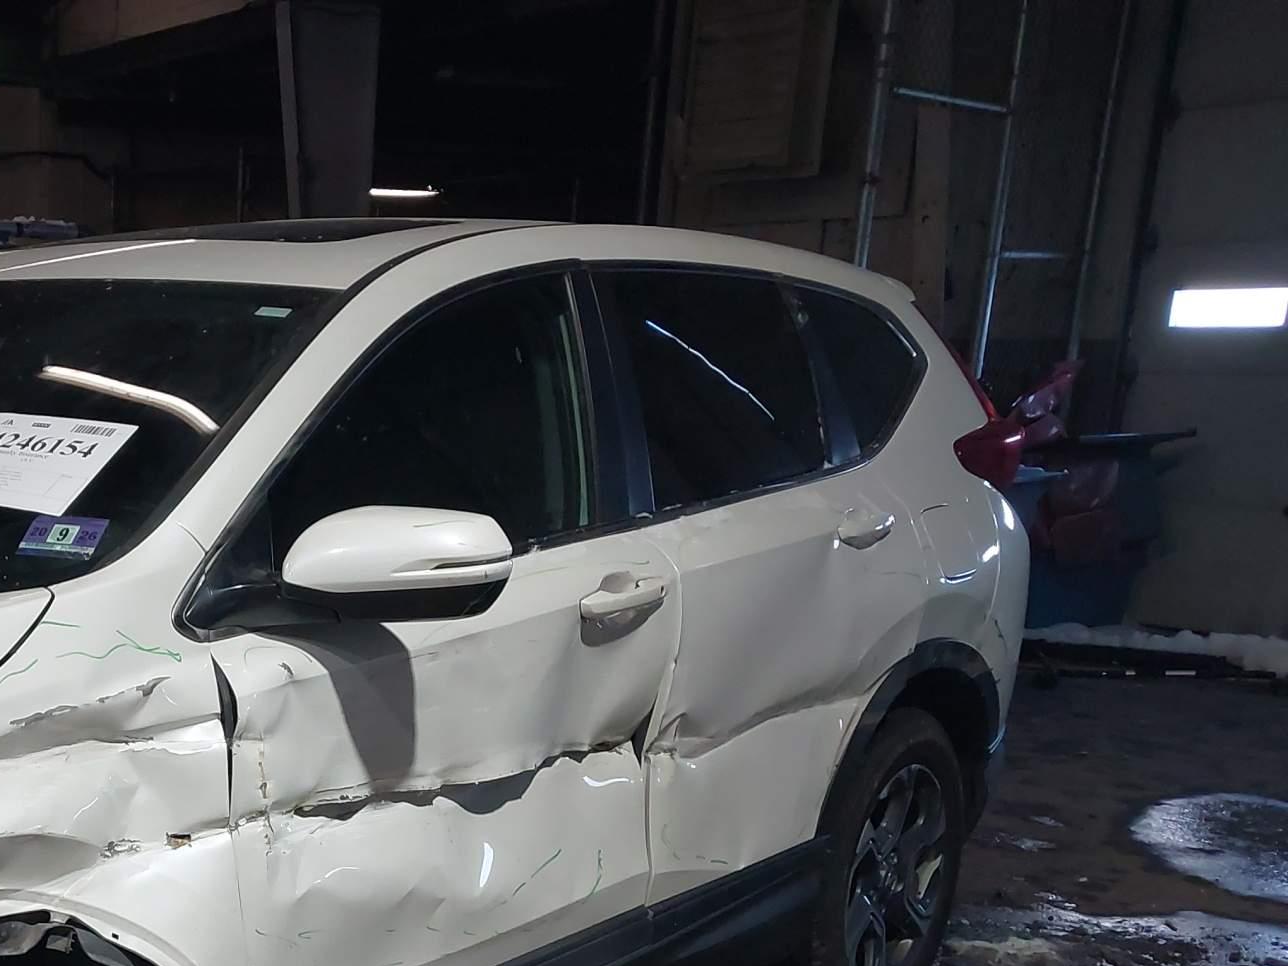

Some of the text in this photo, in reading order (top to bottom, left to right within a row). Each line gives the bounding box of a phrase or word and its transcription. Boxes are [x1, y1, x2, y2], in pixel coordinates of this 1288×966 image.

[30, 527, 98, 542] 20 9 26
